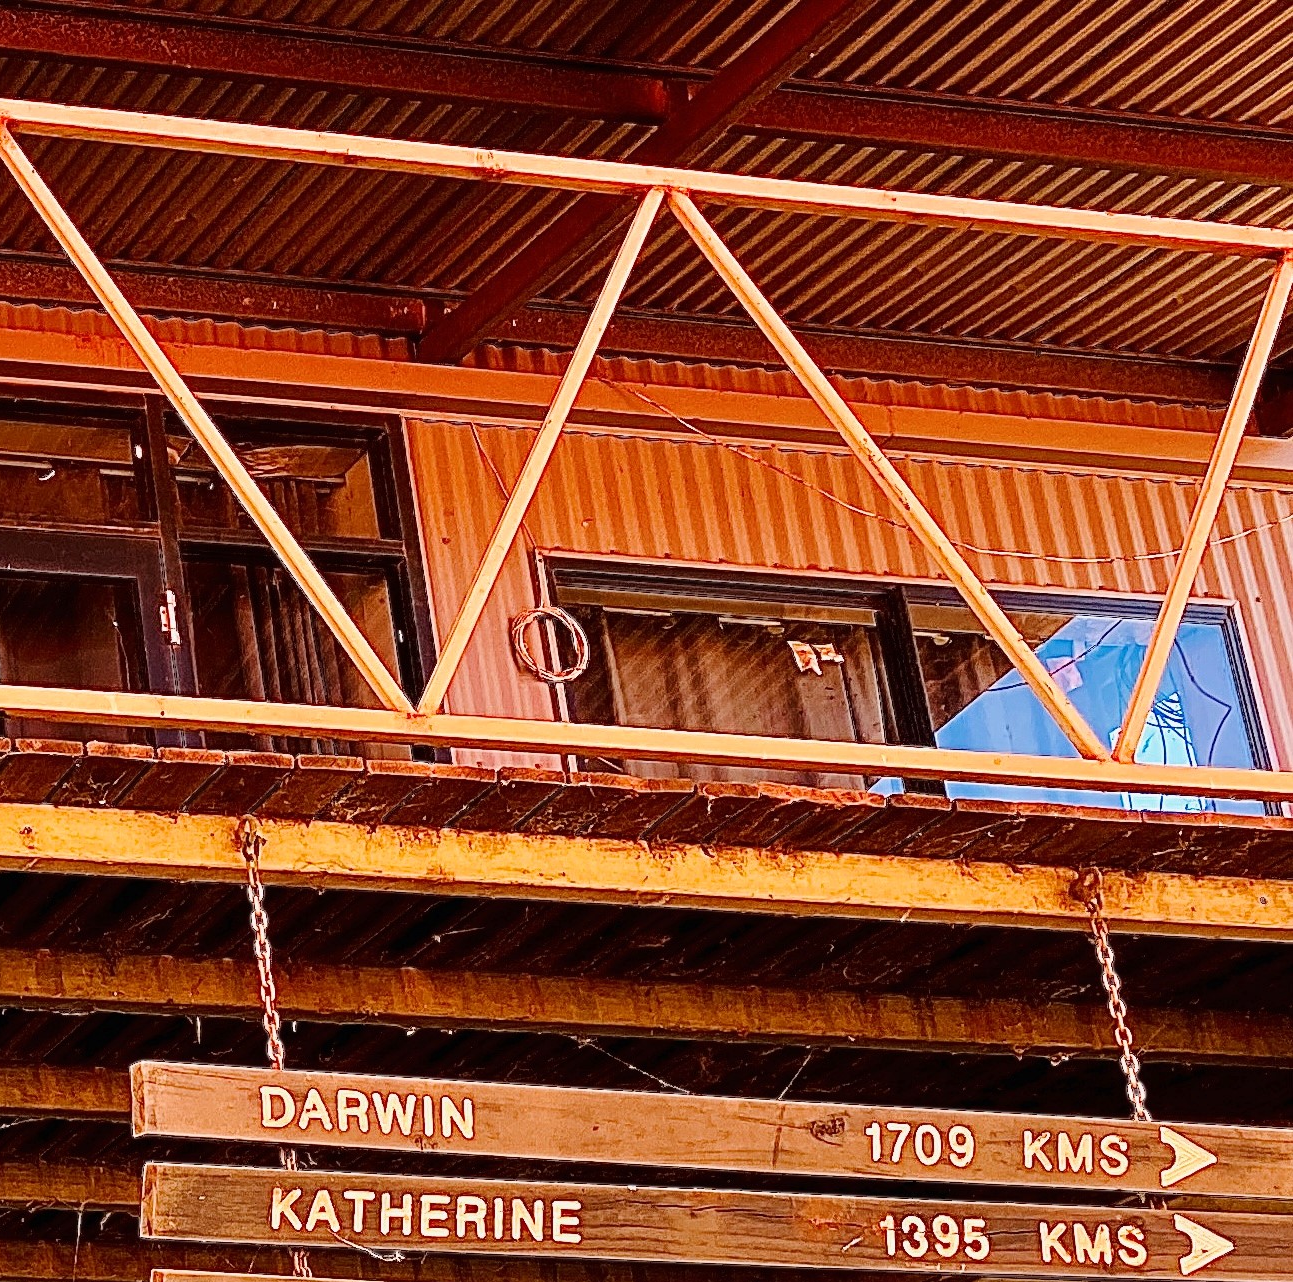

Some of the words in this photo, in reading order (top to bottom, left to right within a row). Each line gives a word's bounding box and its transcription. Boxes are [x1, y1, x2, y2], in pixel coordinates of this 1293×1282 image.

[258, 1084, 476, 1140] DARWIN
[863, 1120, 977, 1170] 1709
[1021, 1128, 1131, 1178] KMS
[269, 1187, 584, 1244] KATHERINE
[878, 1212, 992, 1262] 1395
[1037, 1219, 1149, 1268] KMS
